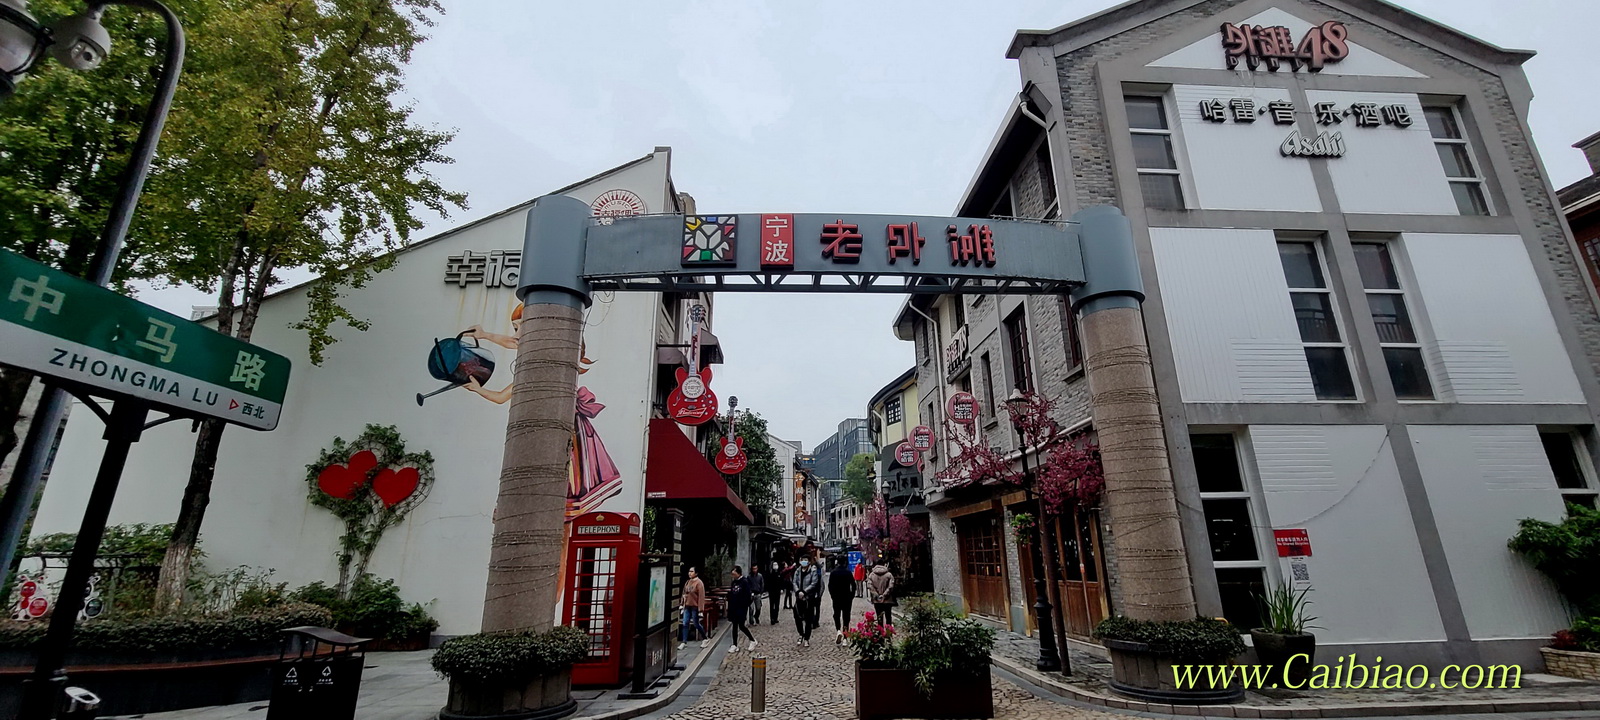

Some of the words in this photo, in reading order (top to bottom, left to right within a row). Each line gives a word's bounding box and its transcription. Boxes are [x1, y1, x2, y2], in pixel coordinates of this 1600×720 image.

[1280, 130, 1347, 157] Asahi
[765, 216, 789, 263] 宁波
[820, 219, 996, 267] 老外滩
[8, 275, 267, 392] 中马路
[49, 348, 180, 397] ZHONGMA
[192, 388, 218, 406] LU
[242, 402, 264, 419] 西北
[579, 526, 620, 534] TELEPHONE
